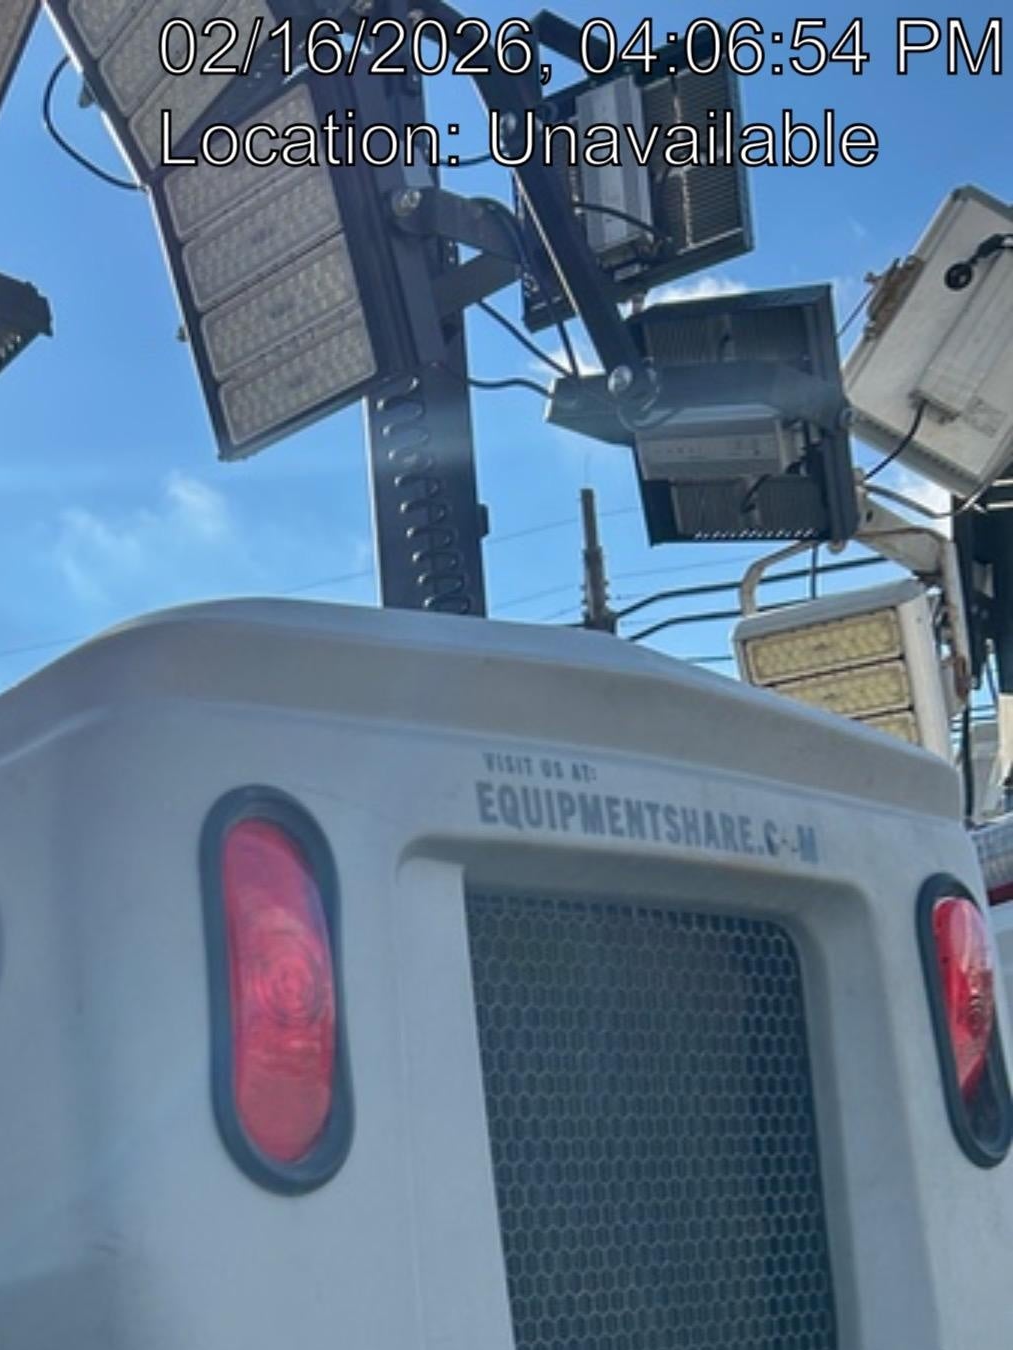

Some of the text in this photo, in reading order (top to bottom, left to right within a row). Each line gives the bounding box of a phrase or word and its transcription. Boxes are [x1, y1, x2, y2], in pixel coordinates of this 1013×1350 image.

[482, 752, 535, 777] VISIT
[541, 760, 565, 781] US
[475, 780, 820, 864] EQUIPMENTSHARE.CM
